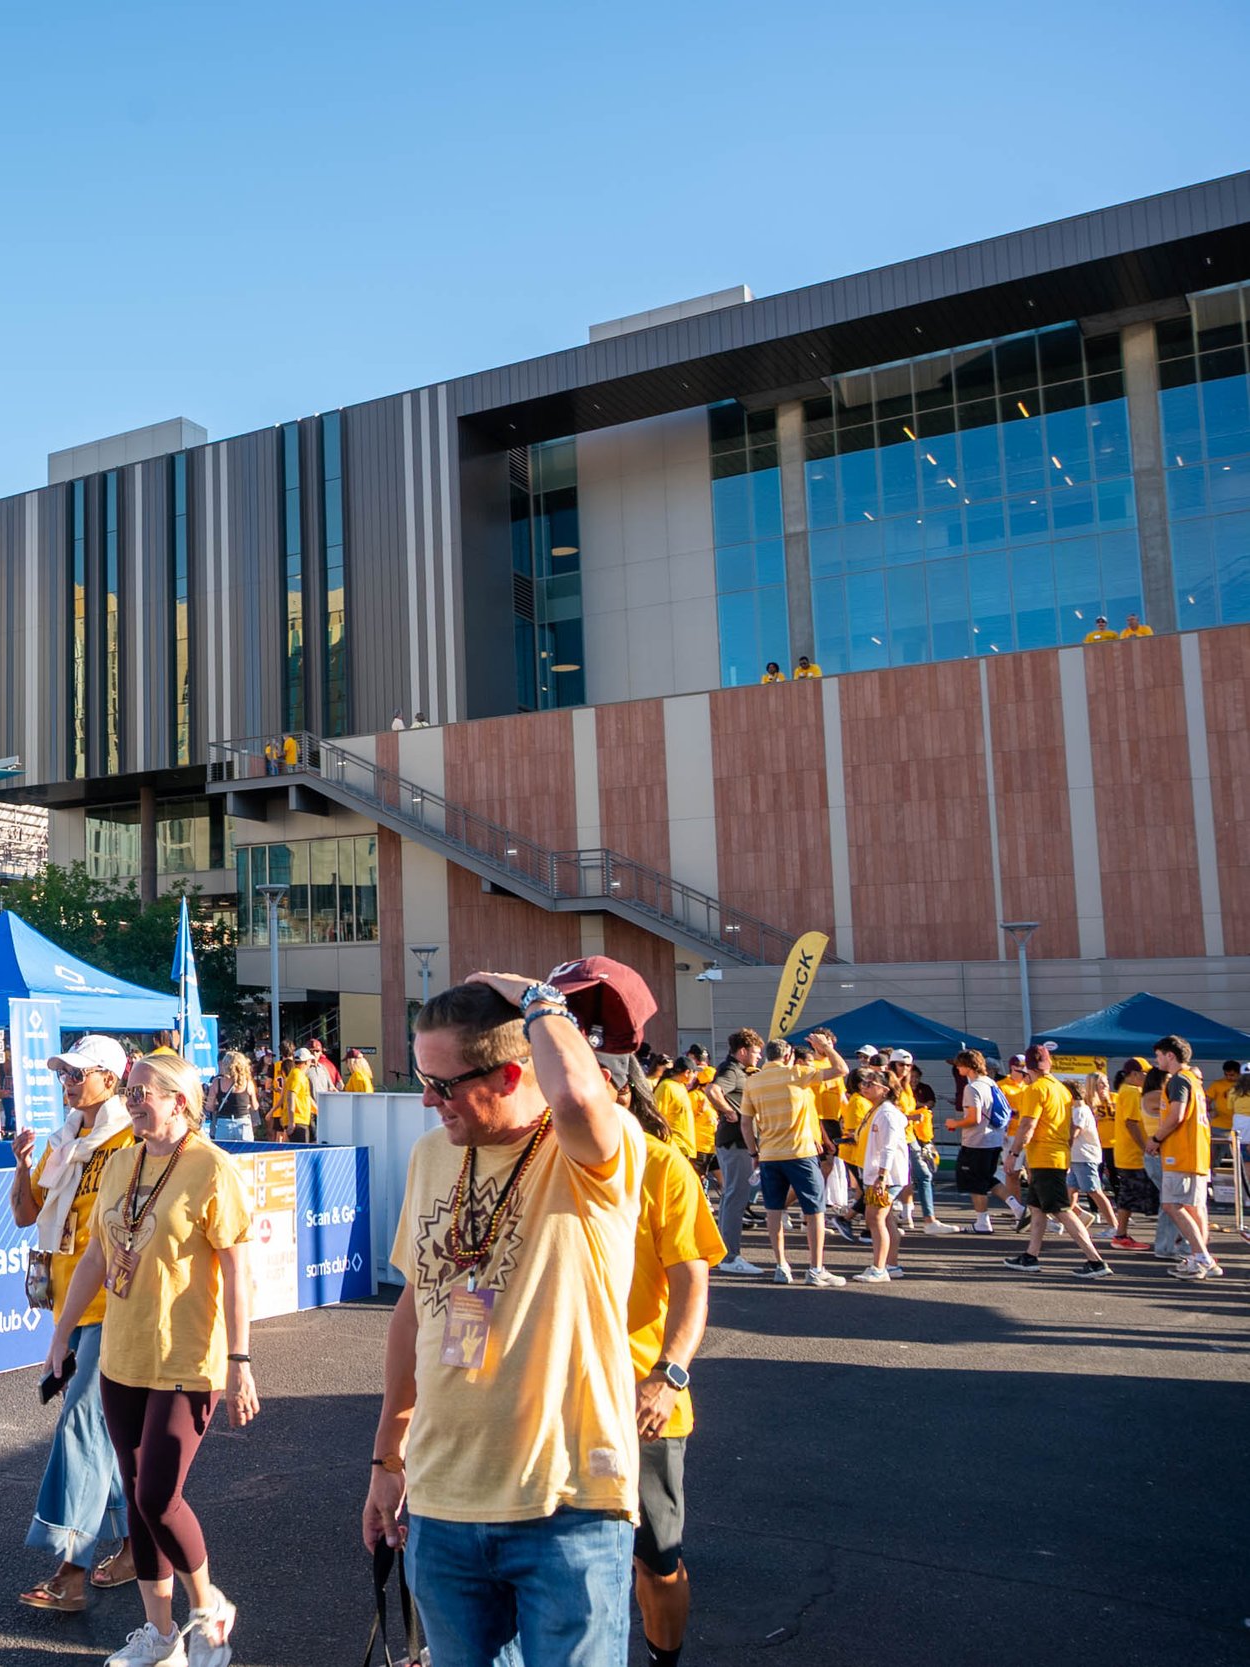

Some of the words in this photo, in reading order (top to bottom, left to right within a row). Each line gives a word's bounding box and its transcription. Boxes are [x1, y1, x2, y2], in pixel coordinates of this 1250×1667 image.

[779, 949, 813, 1033] CHECK
[305, 1209, 331, 1227] Scan
[332, 1206, 341, 1224] &
[305, 1259, 331, 1278] sam's
[332, 1254, 351, 1274] club
